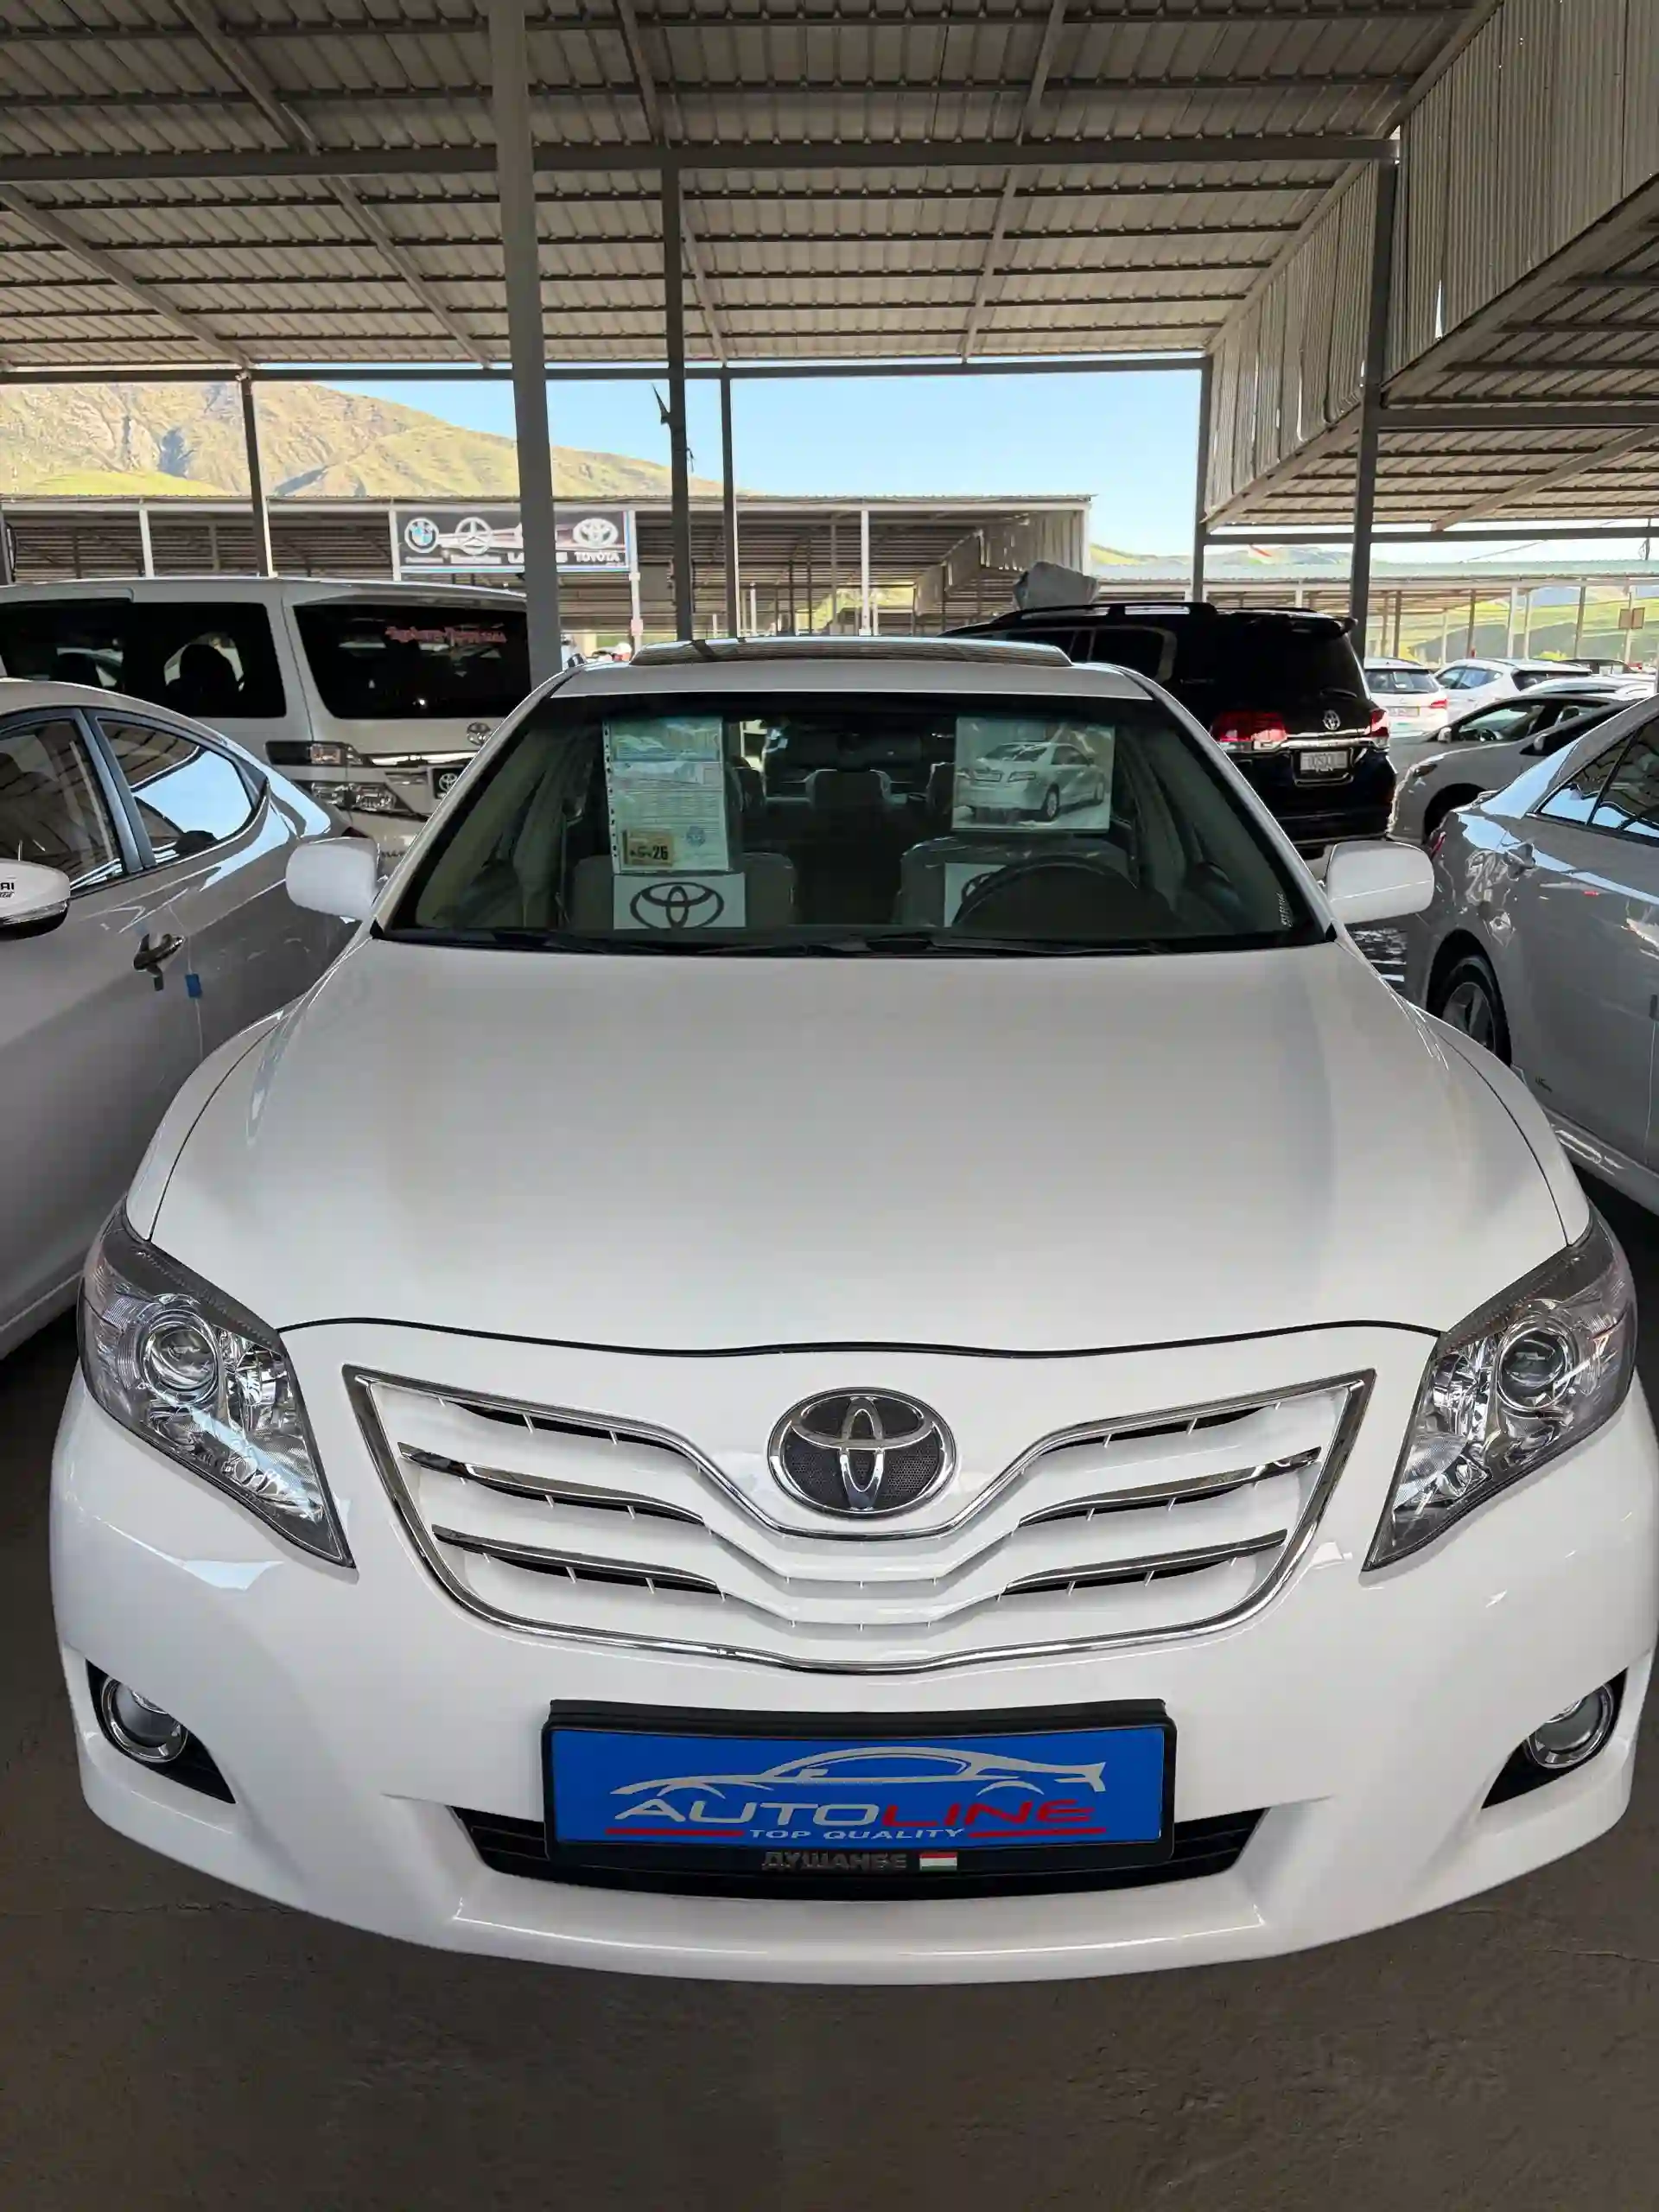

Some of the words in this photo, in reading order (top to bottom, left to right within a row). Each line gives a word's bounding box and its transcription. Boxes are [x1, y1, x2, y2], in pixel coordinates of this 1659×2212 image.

[575, 551, 620, 563] TOYOTA
[614, 1798, 1095, 1827] AUTOLINE
[749, 1829, 811, 1839] TOP
[823, 1827, 965, 1840] QUALITY
[761, 1852, 906, 1871] ДУШАНБЕ
